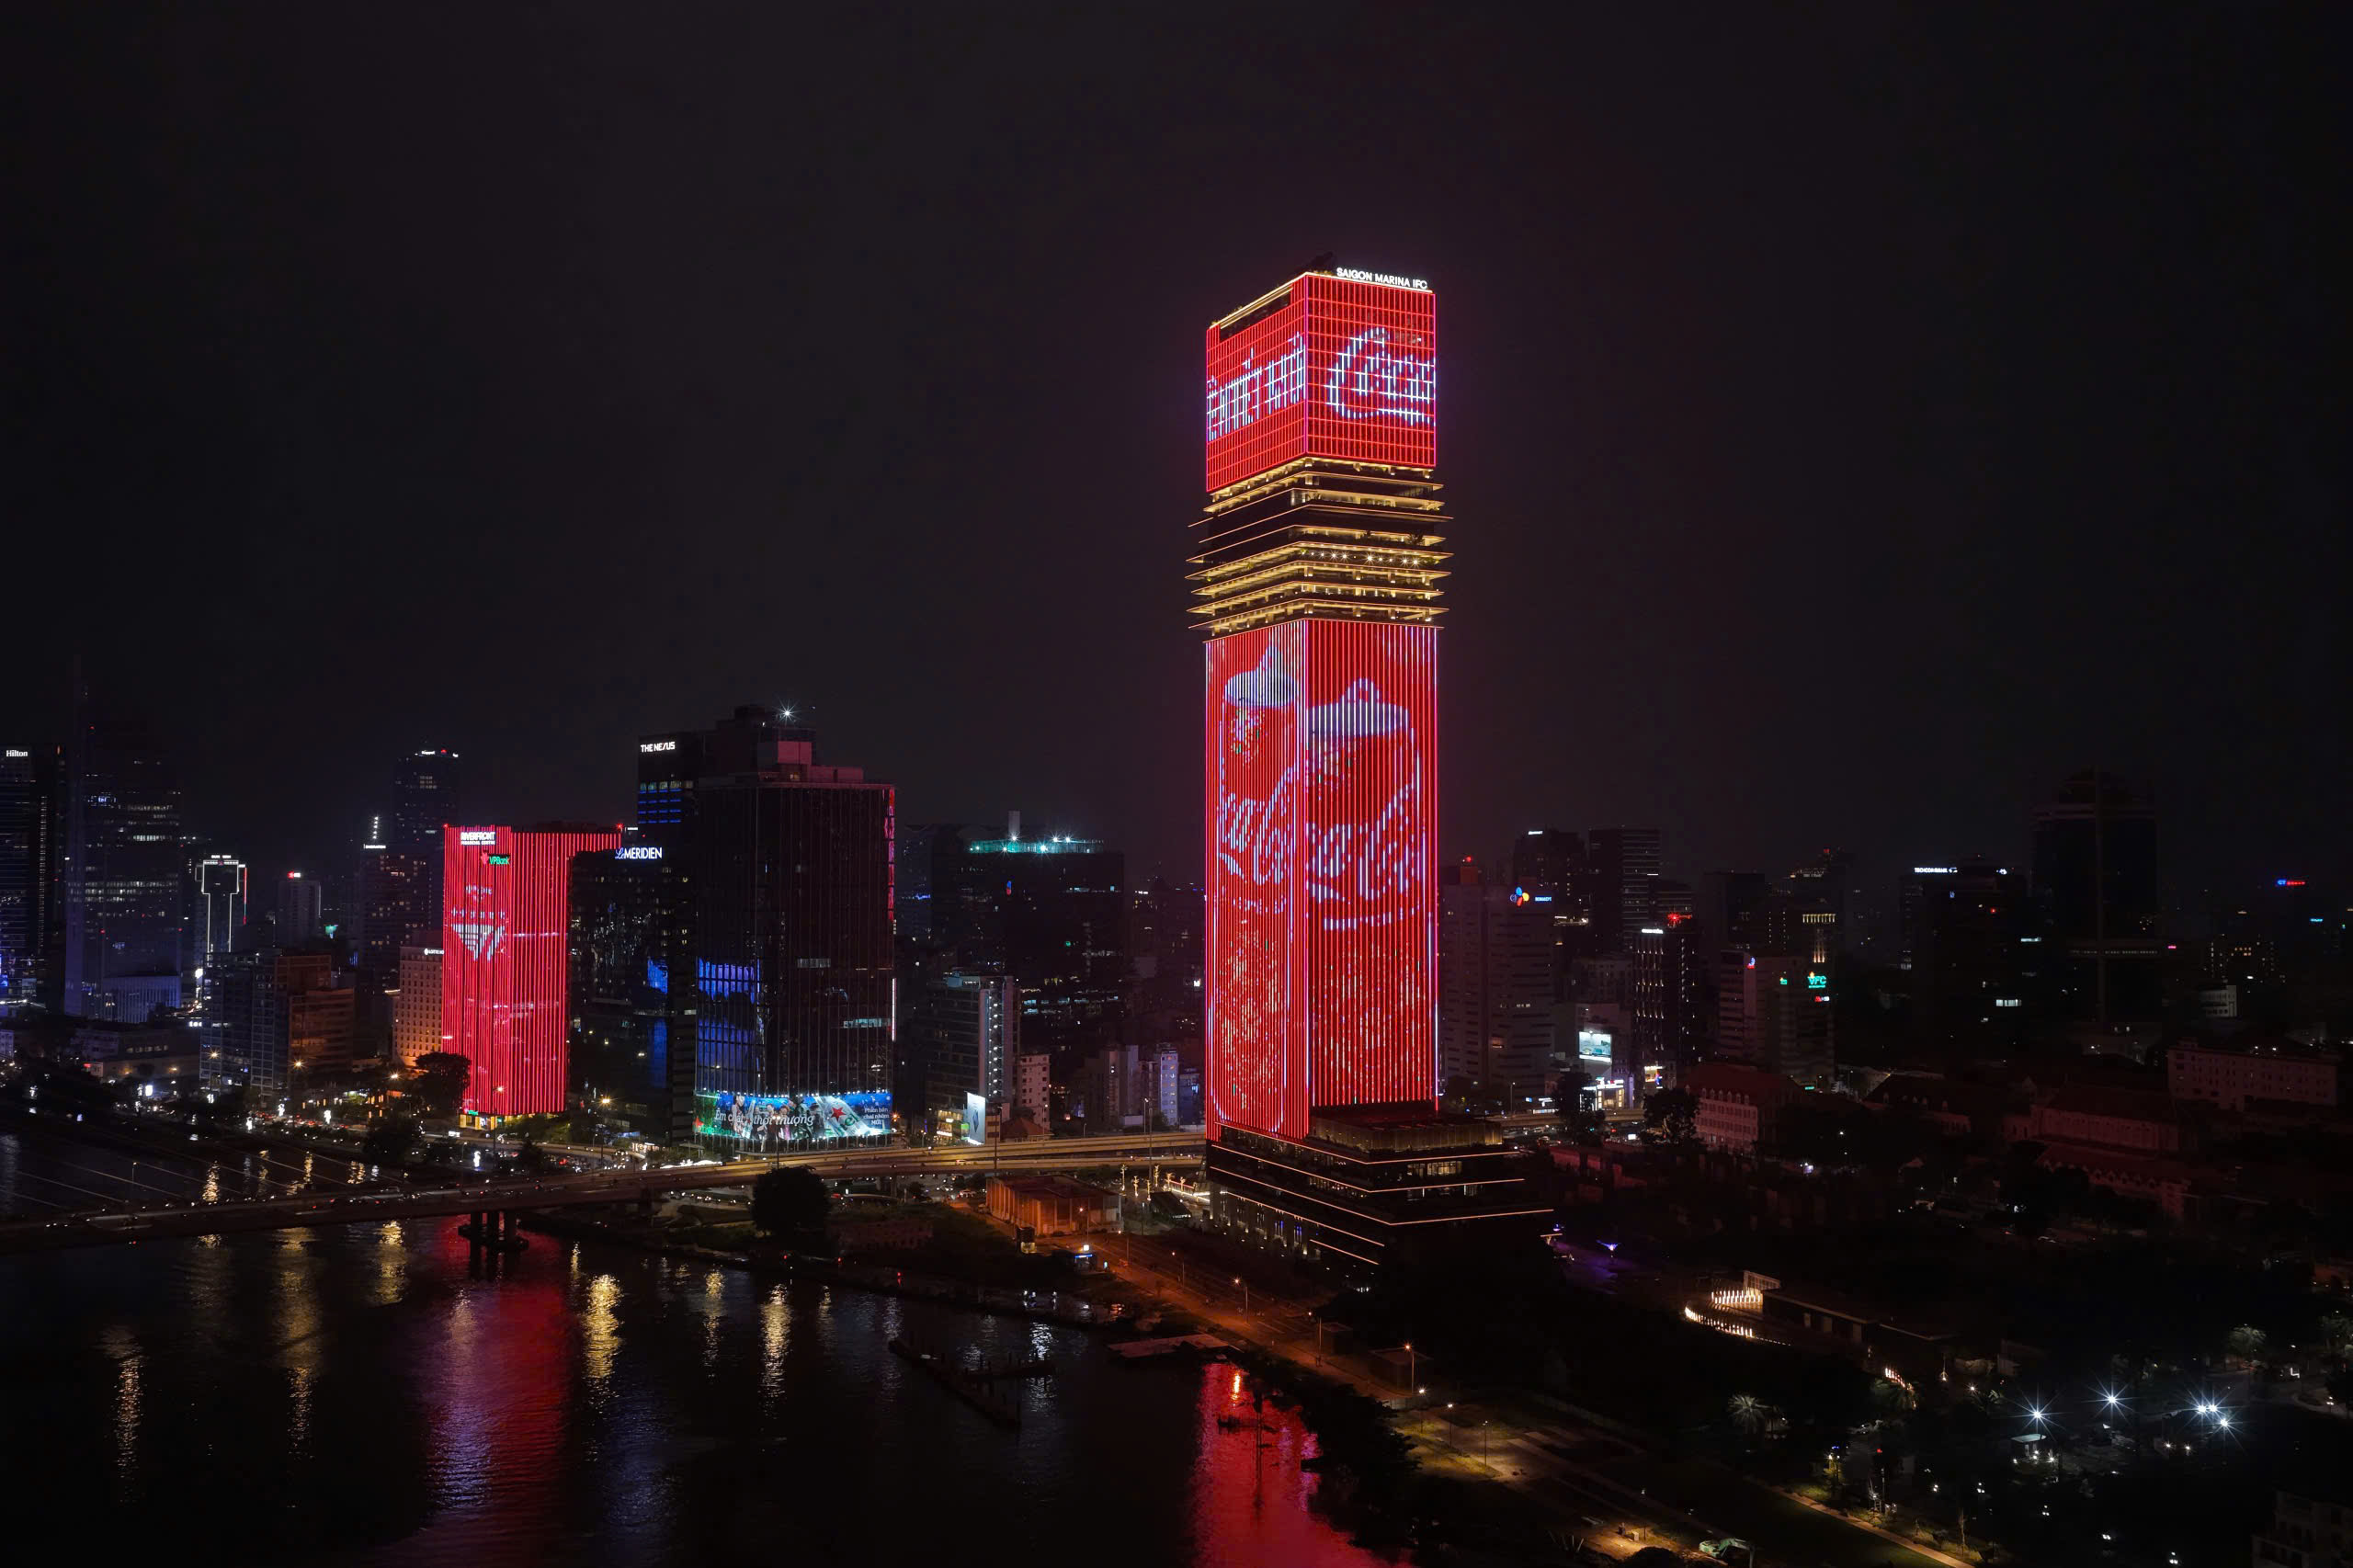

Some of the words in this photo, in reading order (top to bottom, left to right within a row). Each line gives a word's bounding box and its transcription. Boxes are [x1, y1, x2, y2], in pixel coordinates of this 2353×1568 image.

[1336, 267, 1373, 282] SAIGON
[1374, 272, 1411, 287] MARINA
[1412, 278, 1428, 290] IFC
[640, 743, 654, 753] THE
[654, 741, 676, 752] NEXUS
[6, 749, 28, 757] Hilton
[460, 831, 495, 841] RIVERFRONT
[624, 846, 663, 859] MERIDIEN
[488, 855, 510, 865] VPBank
